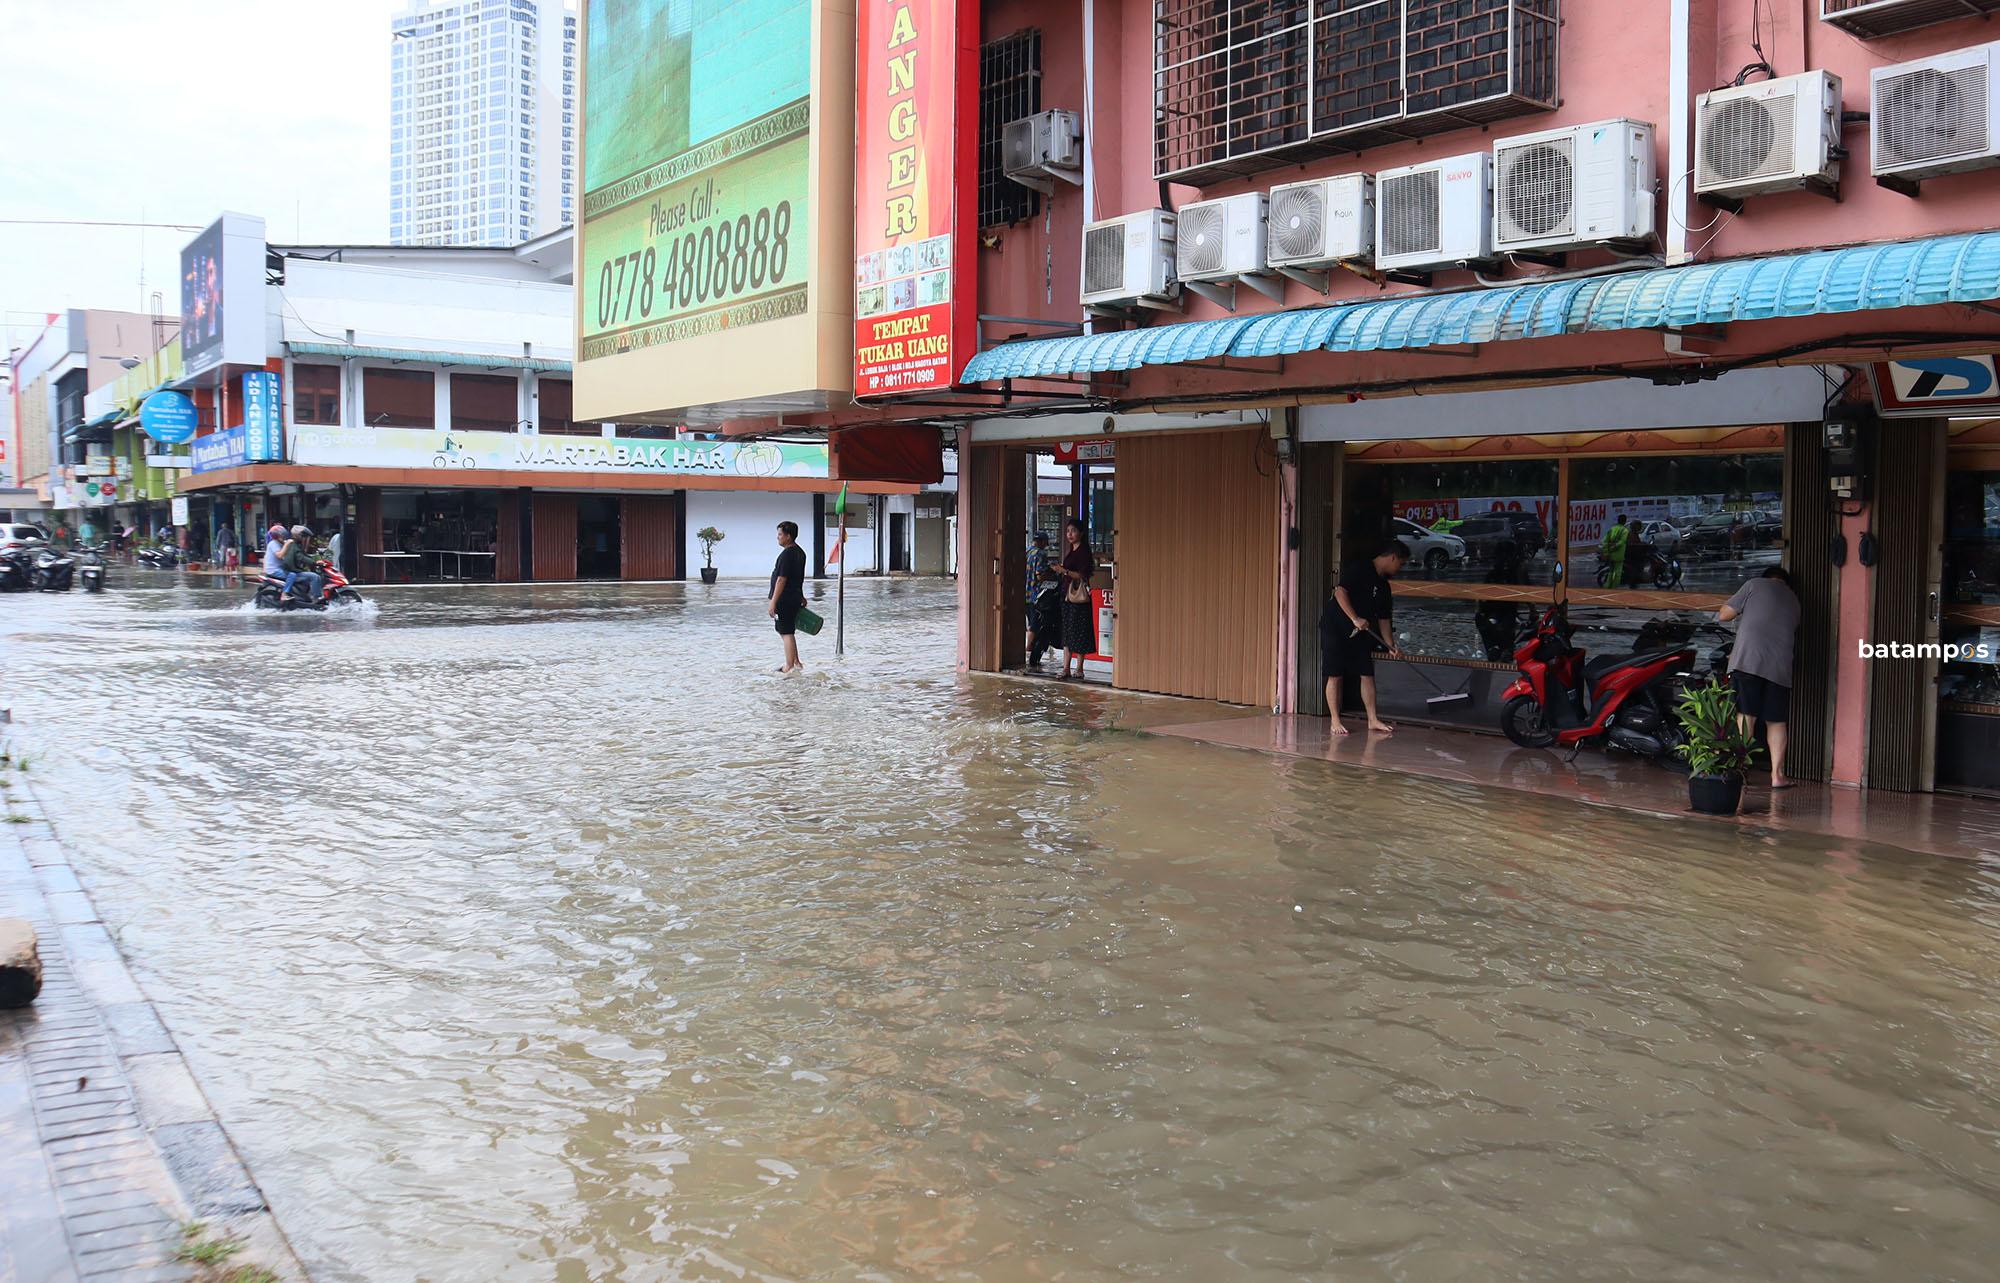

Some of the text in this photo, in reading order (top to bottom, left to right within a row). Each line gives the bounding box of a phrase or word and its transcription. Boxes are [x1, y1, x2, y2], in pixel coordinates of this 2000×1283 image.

[885, 0, 918, 238] ANGER
[1447, 170, 1473, 182] SANYO
[649, 201, 686, 238] Please
[690, 177, 714, 223] Call
[598, 200, 791, 329] 0778 4808888
[873, 314, 931, 340] TEMPAT
[858, 335, 948, 364] TUKAR UANG
[248, 373, 262, 418] INDIAN
[269, 373, 278, 418] INDIAN
[870, 376, 880, 388] HP
[903, 371, 916, 384] 771
[916, 368, 935, 382] 0909
[515, 440, 725, 470] MARTABAK HAR
